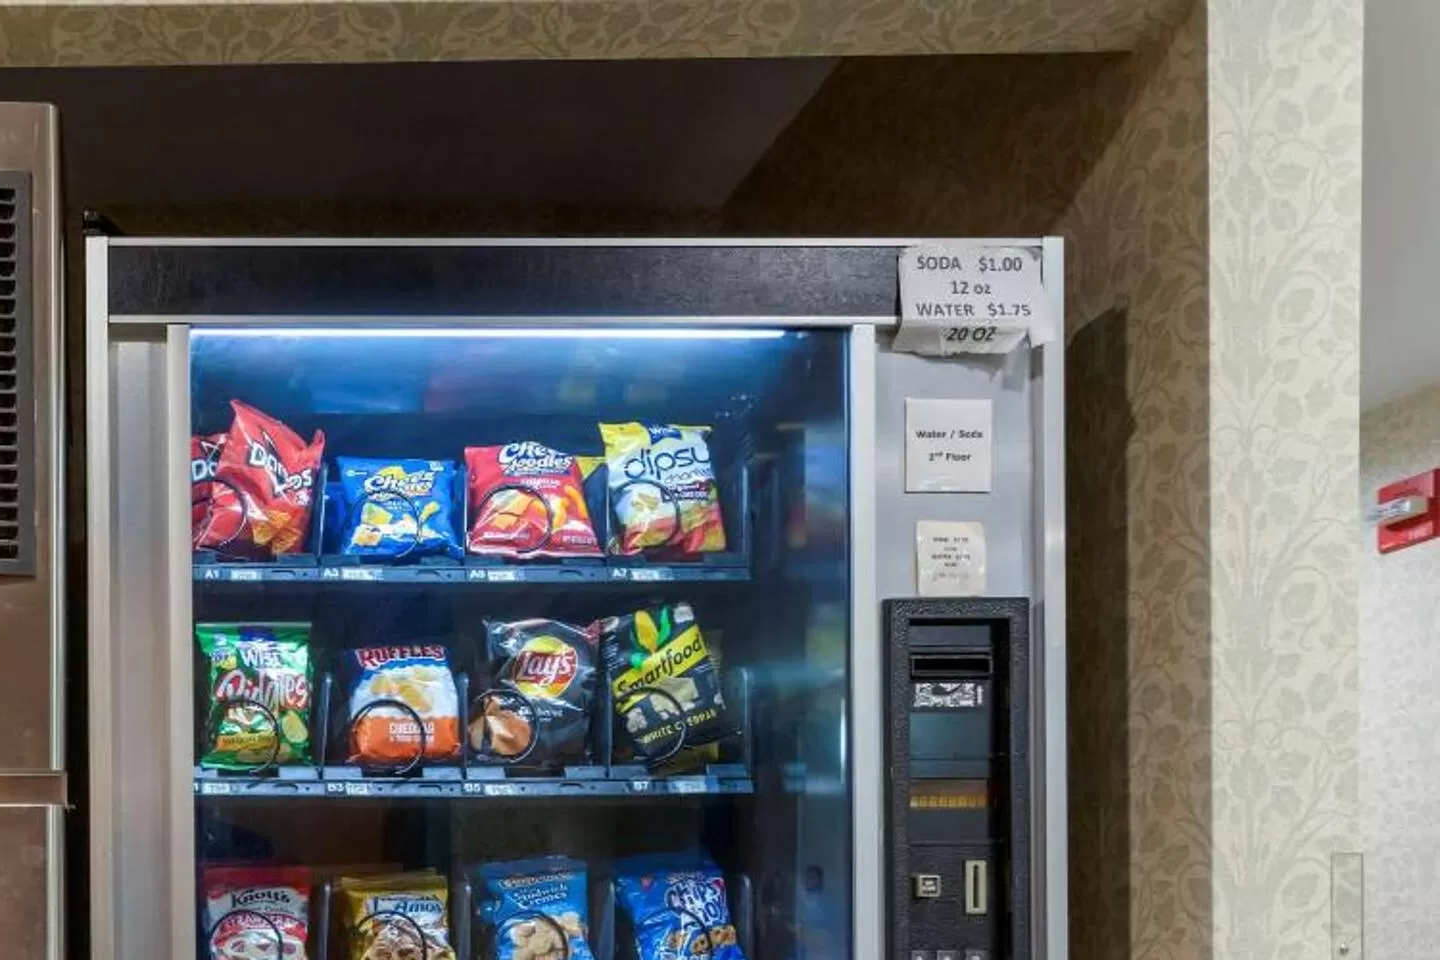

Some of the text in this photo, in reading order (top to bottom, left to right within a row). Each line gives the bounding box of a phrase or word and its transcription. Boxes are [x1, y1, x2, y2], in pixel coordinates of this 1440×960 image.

[916, 255, 1023, 272] SODA $1.00
[951, 280, 992, 295] 12 oz
[915, 301, 1032, 317] WATER $1.75
[946, 327, 969, 341] 20
[915, 429, 947, 439] Water
[515, 652, 573, 686] Lay's
